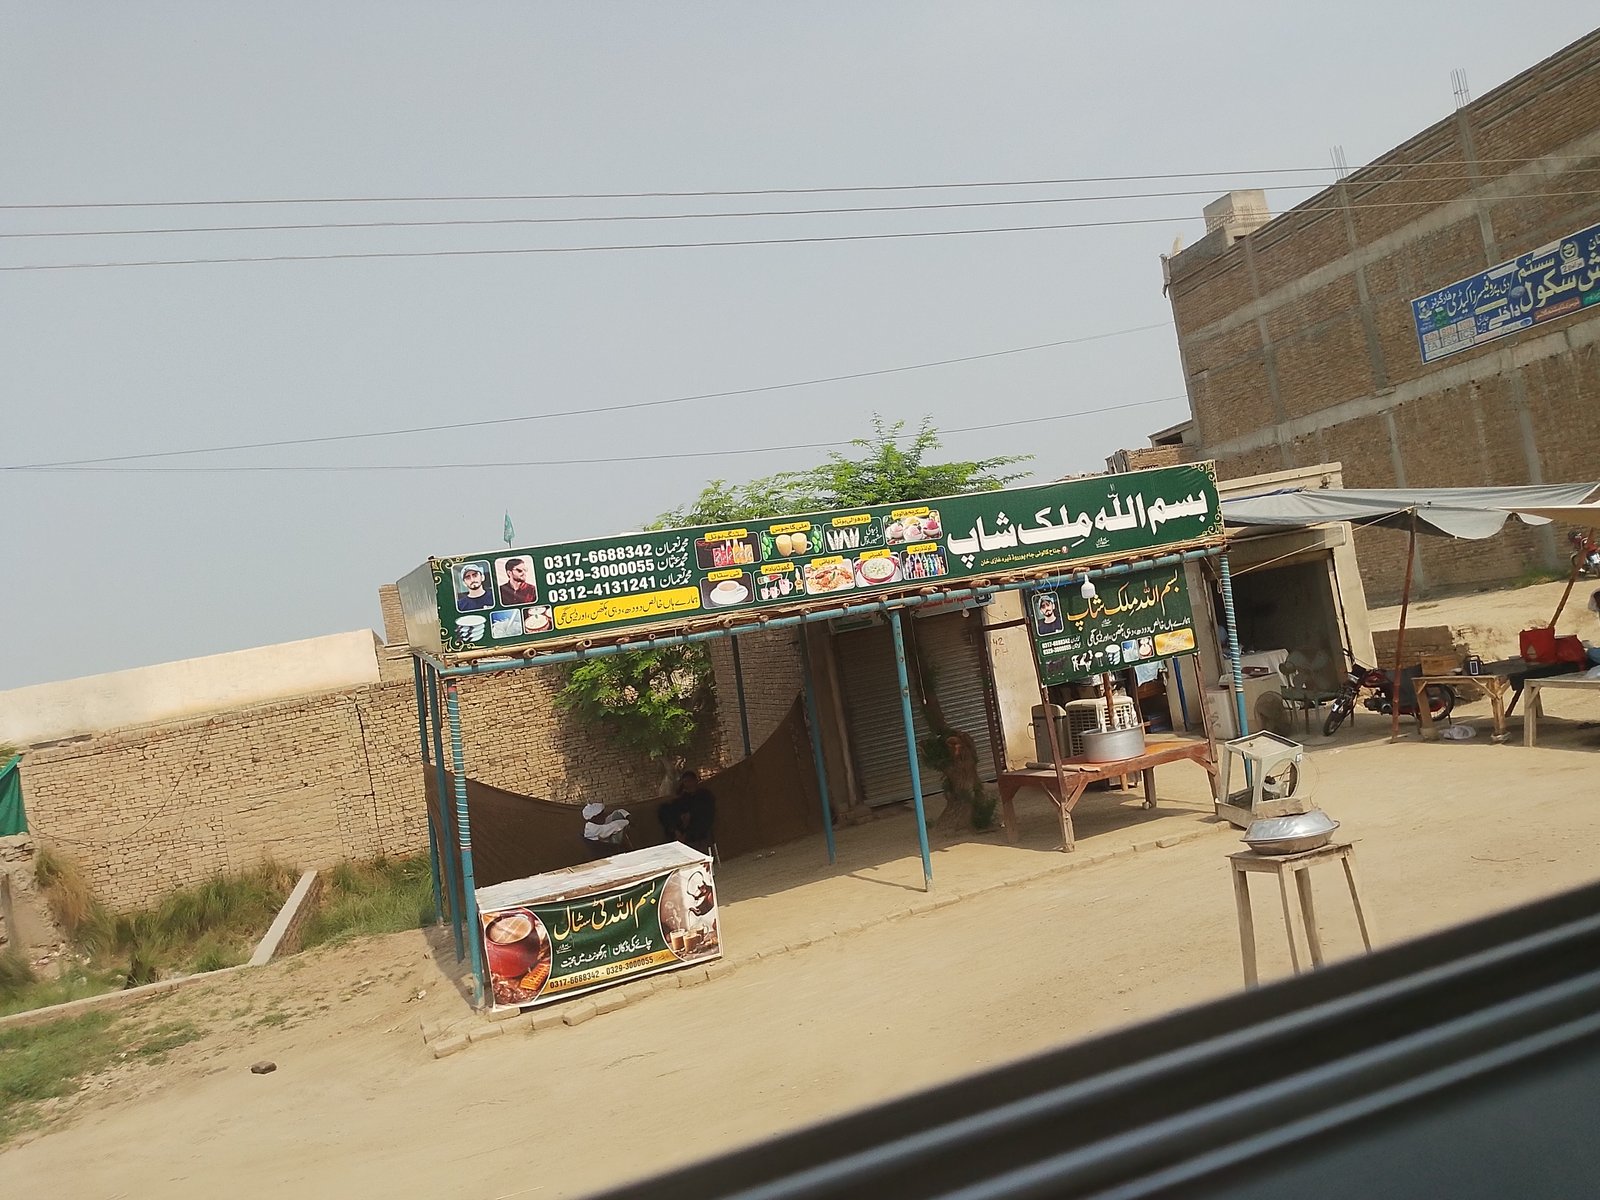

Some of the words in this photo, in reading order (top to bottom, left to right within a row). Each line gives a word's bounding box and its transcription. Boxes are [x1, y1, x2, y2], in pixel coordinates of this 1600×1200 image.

[1147, 489, 1209, 535] بسم
[543, 543, 652, 570] 0317-6688342
[947, 511, 1019, 570] شاپ
[545, 559, 655, 586] 0329-3000055
[548, 576, 656, 603] 0312-4131241
[1161, 568, 1180, 617] بسم
[592, 899, 607, 930] ٹی
[634, 881, 656, 928] بسم
[553, 905, 592, 941] سٹال
[550, 969, 600, 989] 0317-6688342
[606, 956, 654, 976] 0329-3000055
